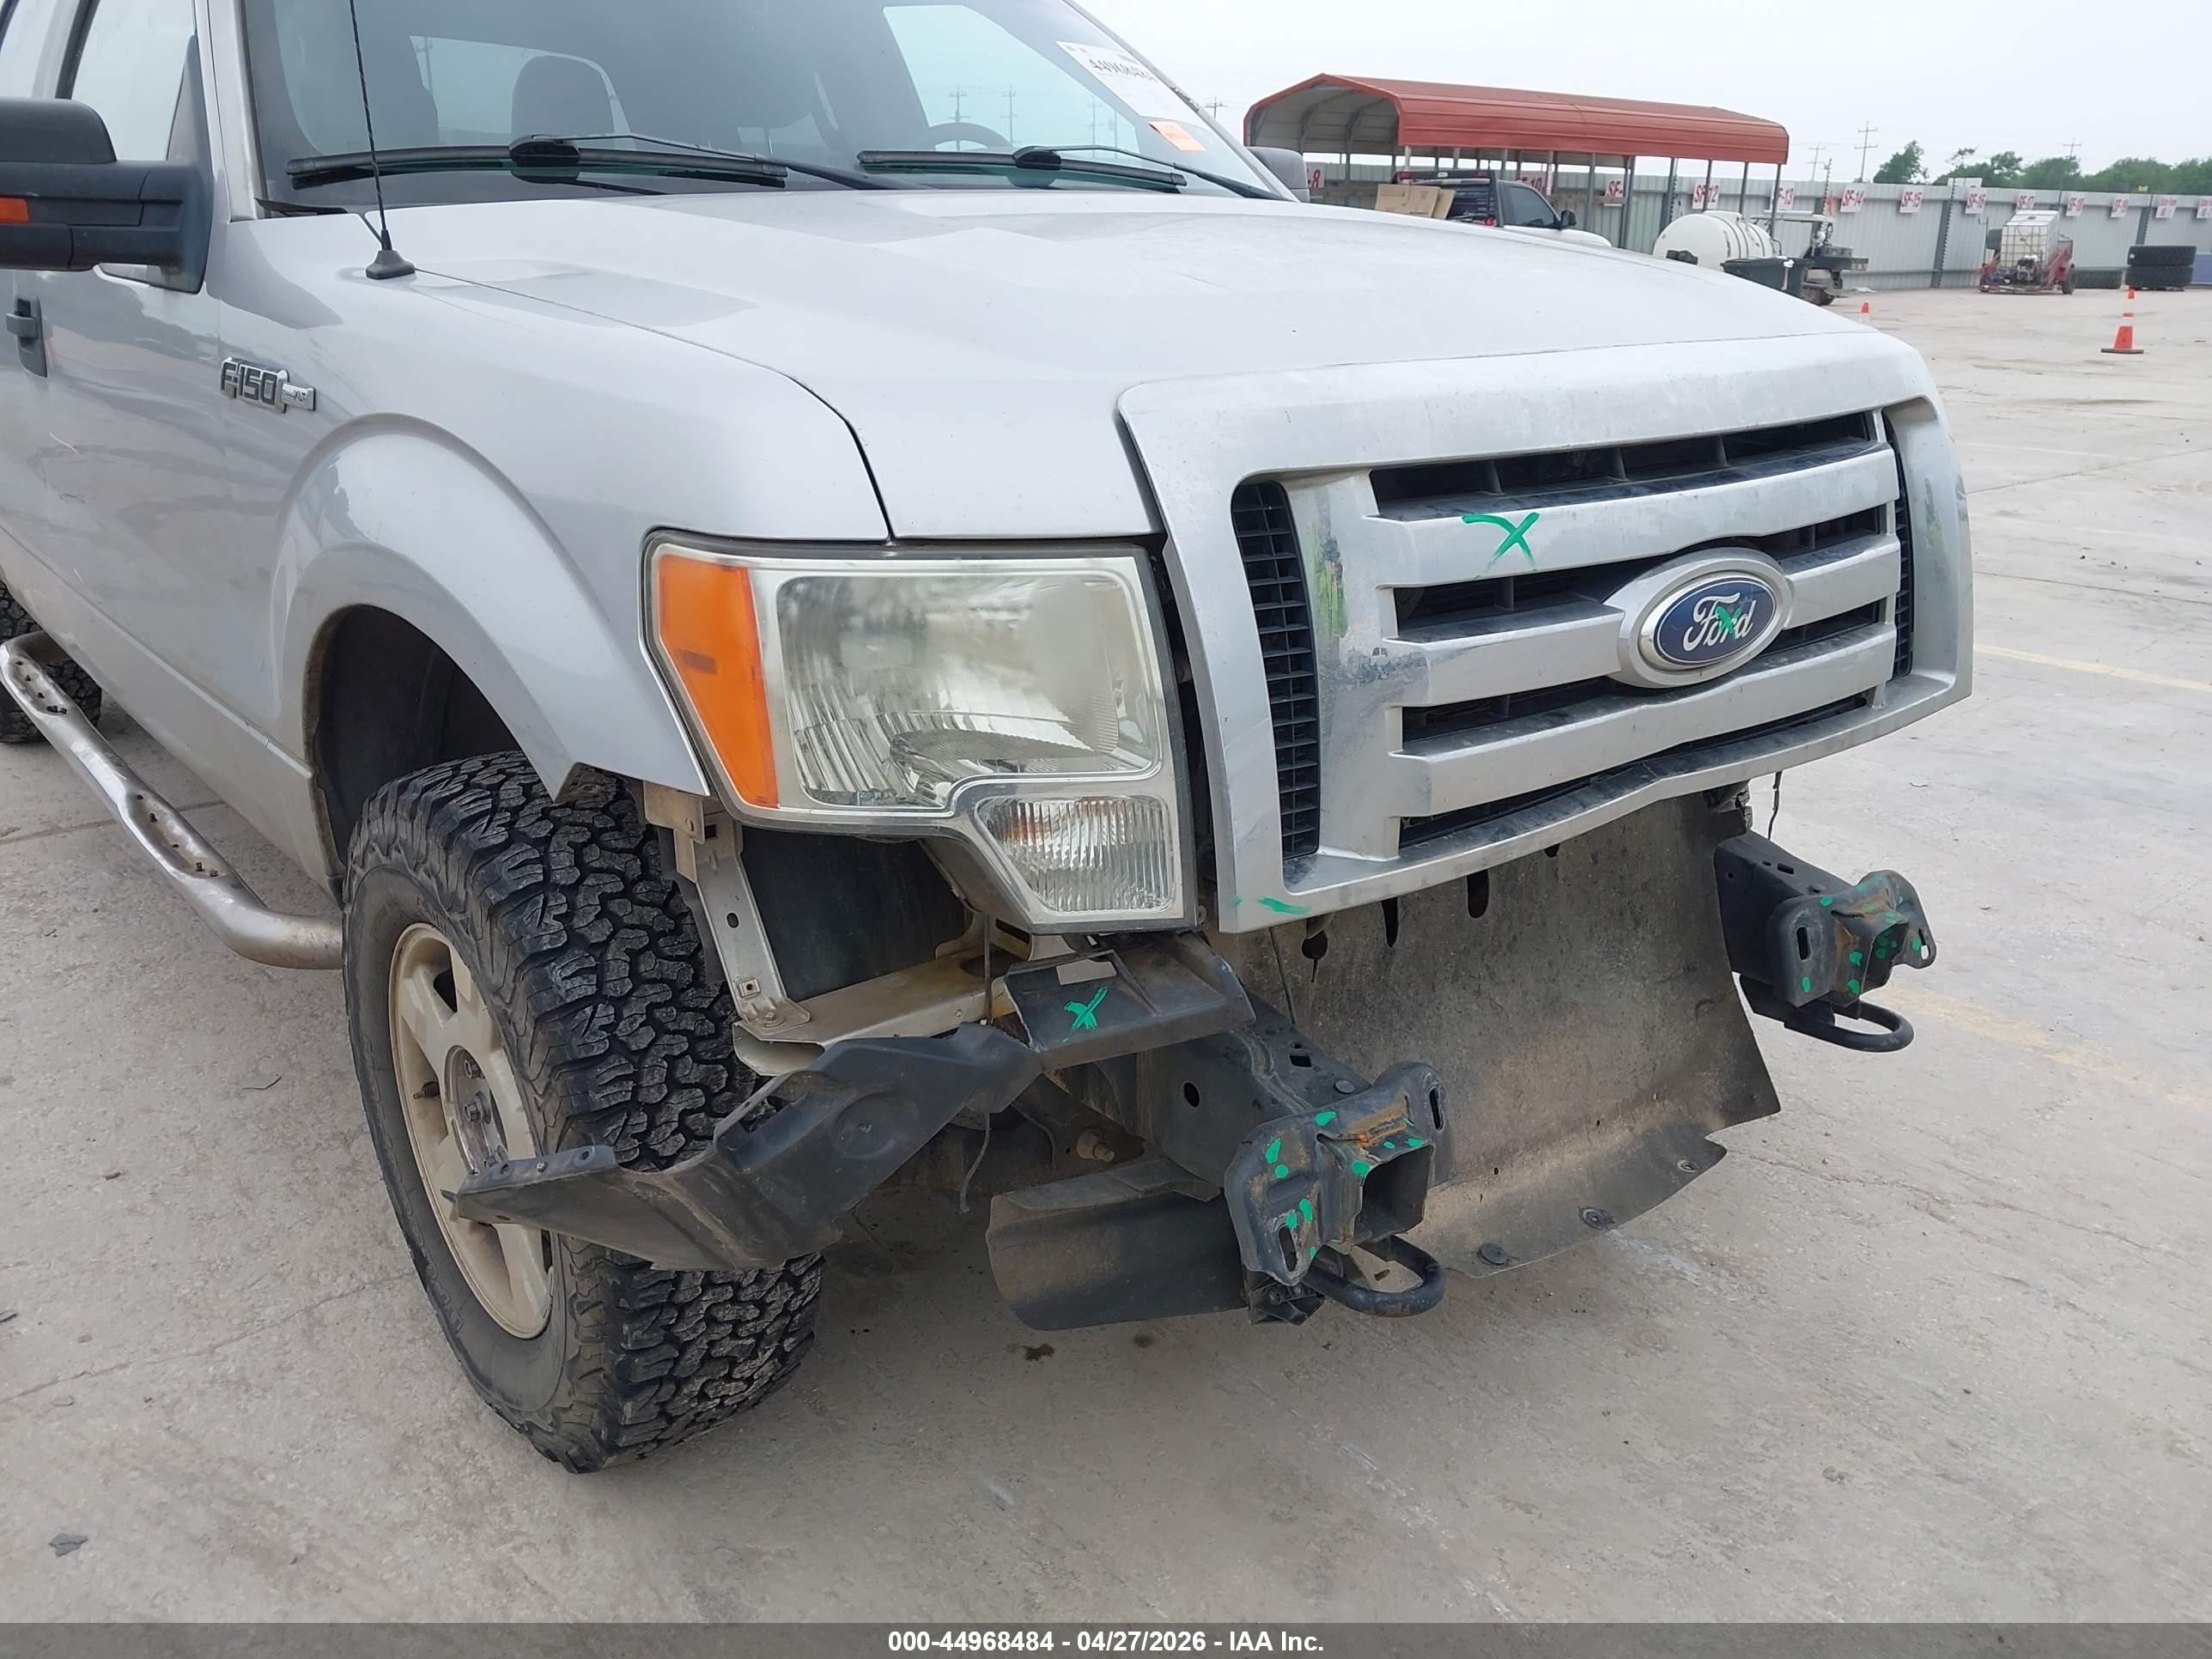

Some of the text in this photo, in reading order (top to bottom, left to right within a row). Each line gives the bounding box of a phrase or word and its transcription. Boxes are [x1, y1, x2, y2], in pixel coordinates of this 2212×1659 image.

[1842, 189, 1864, 207] SF-14
[1900, 191, 1923, 208] SF-15
[1682, 591, 1757, 653] Ford
